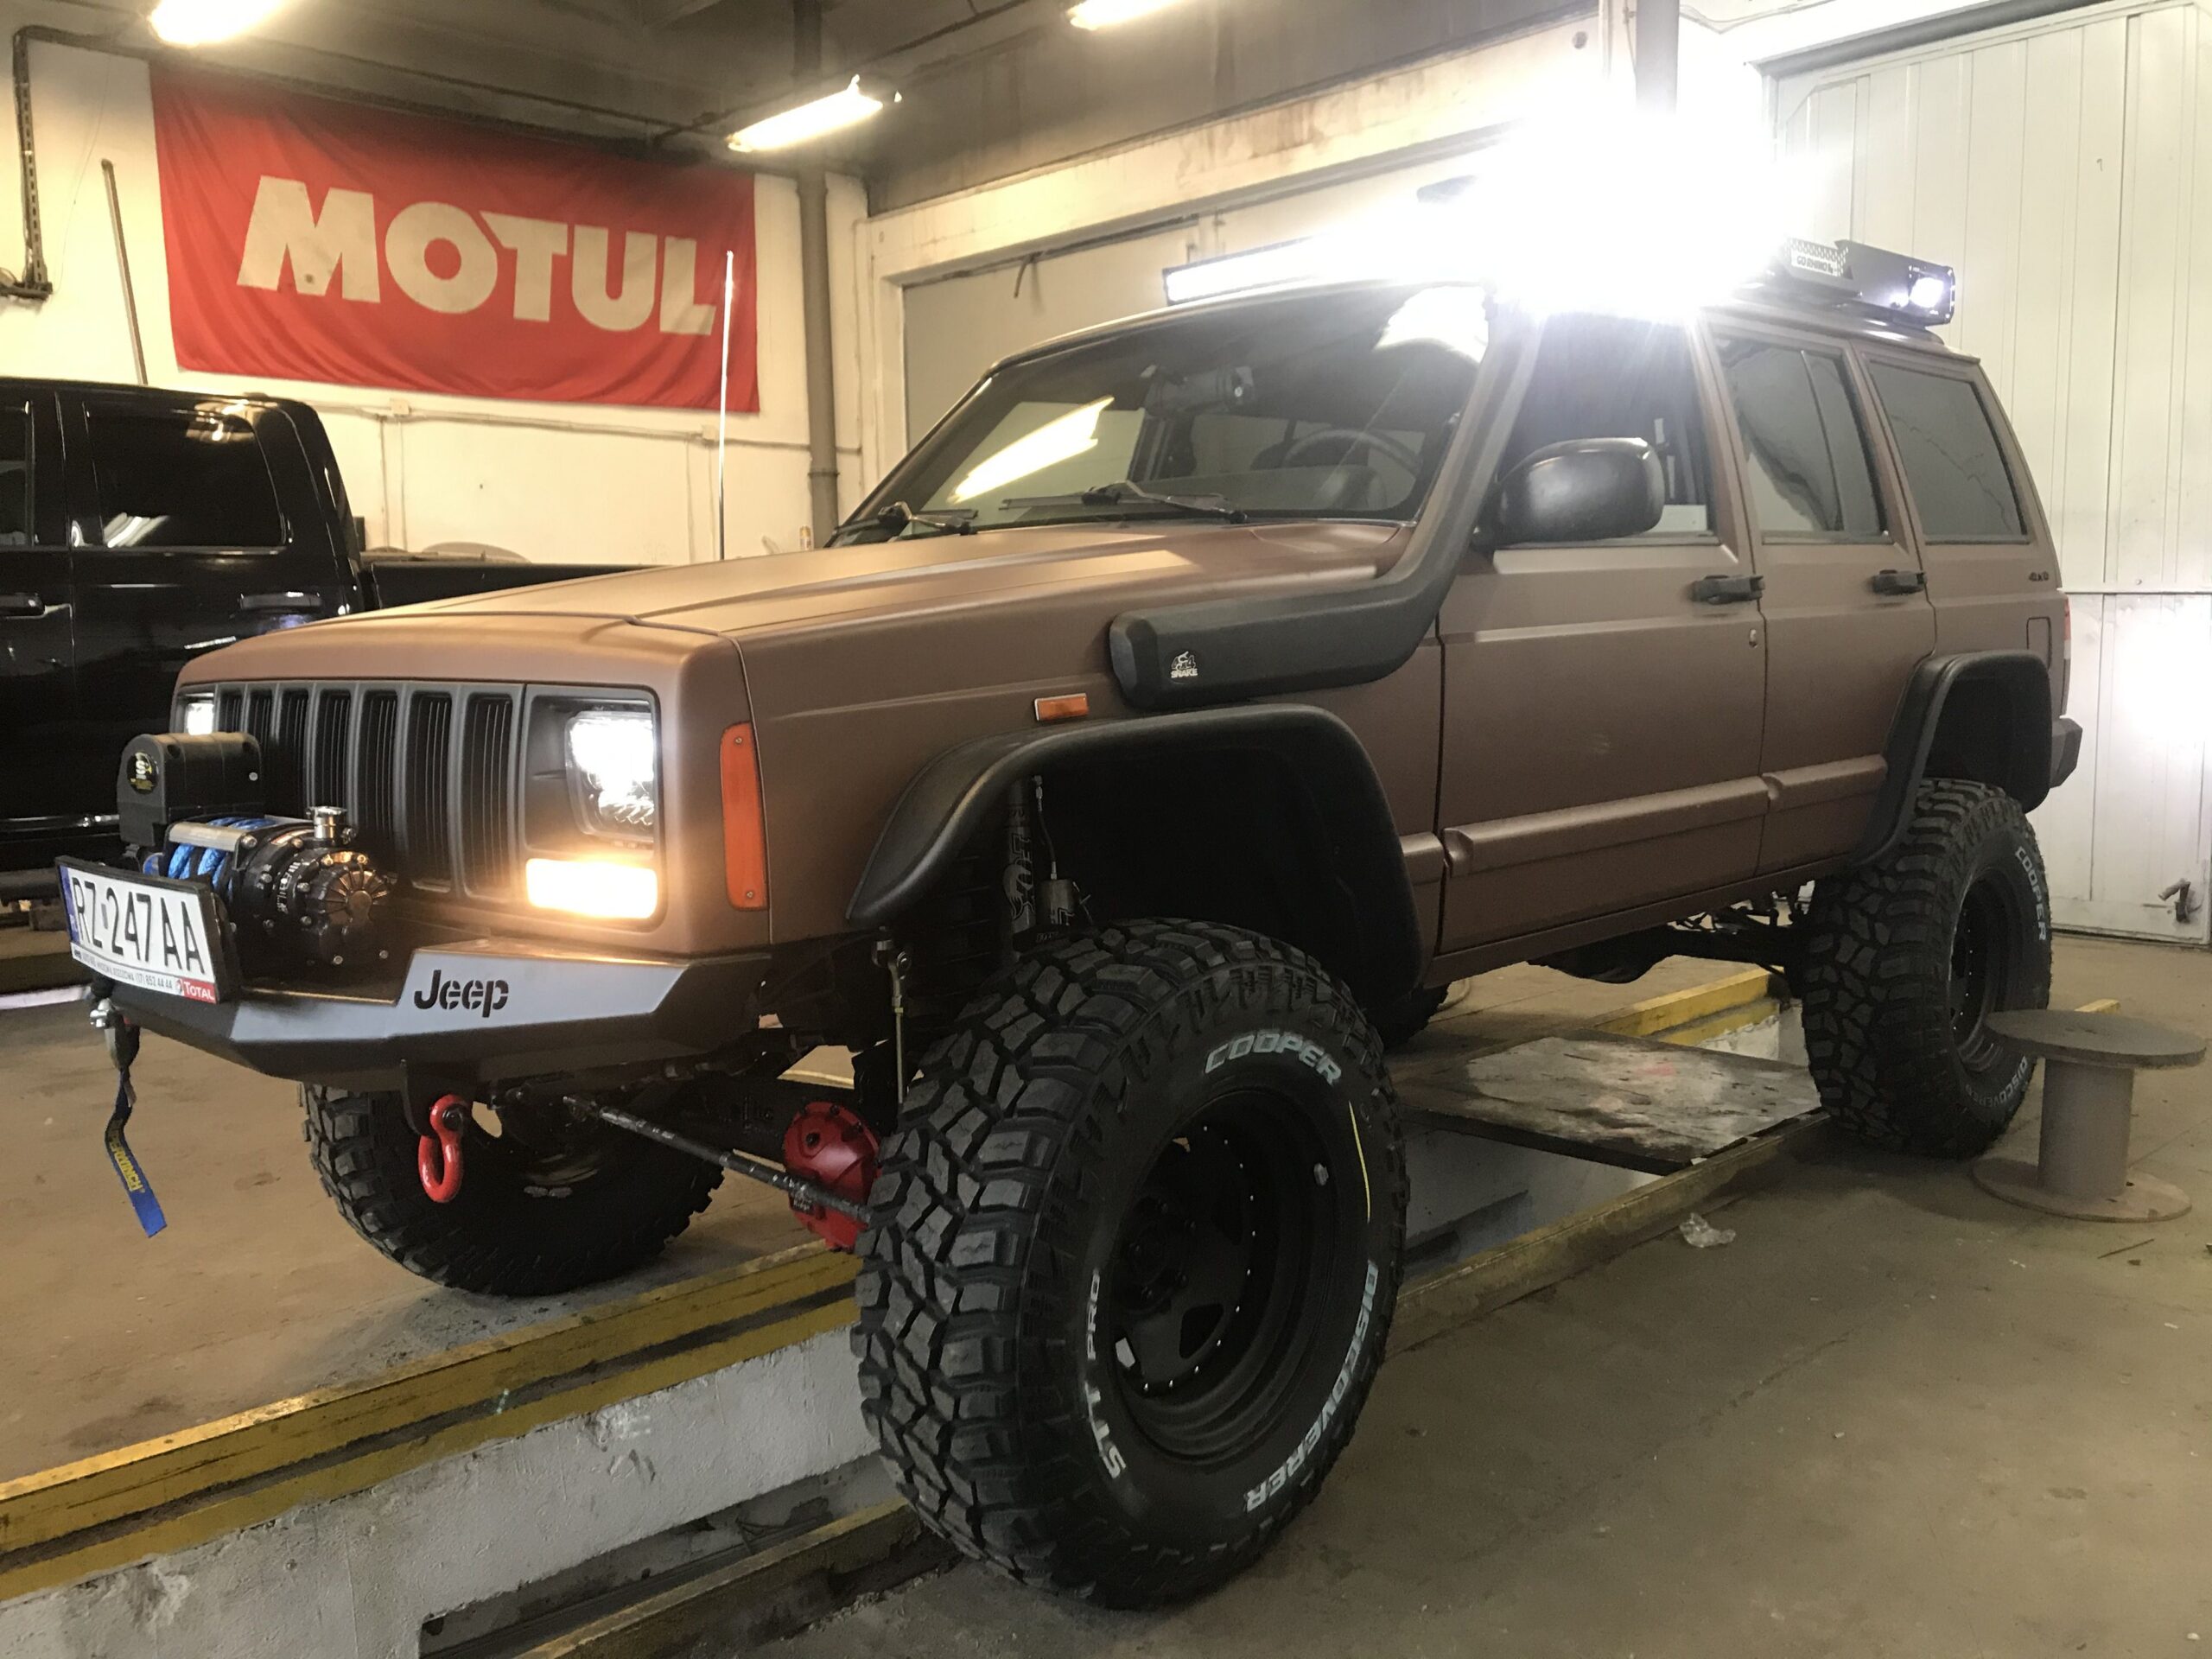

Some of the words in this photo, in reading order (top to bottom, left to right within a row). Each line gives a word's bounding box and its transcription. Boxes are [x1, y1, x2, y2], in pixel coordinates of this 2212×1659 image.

[238, 175, 716, 336] MOTUL
[72, 877, 103, 948] RZ
[106, 887, 206, 974] 247AA
[2015, 845, 2047, 941] COOPER
[413, 969, 510, 1018] Jeep
[1204, 1030, 1342, 1086] COOPER
[1087, 1268, 1101, 1360] PRO
[1084, 1380, 1127, 1479] STT
[1243, 1259, 1379, 1514] DISCOVERER
